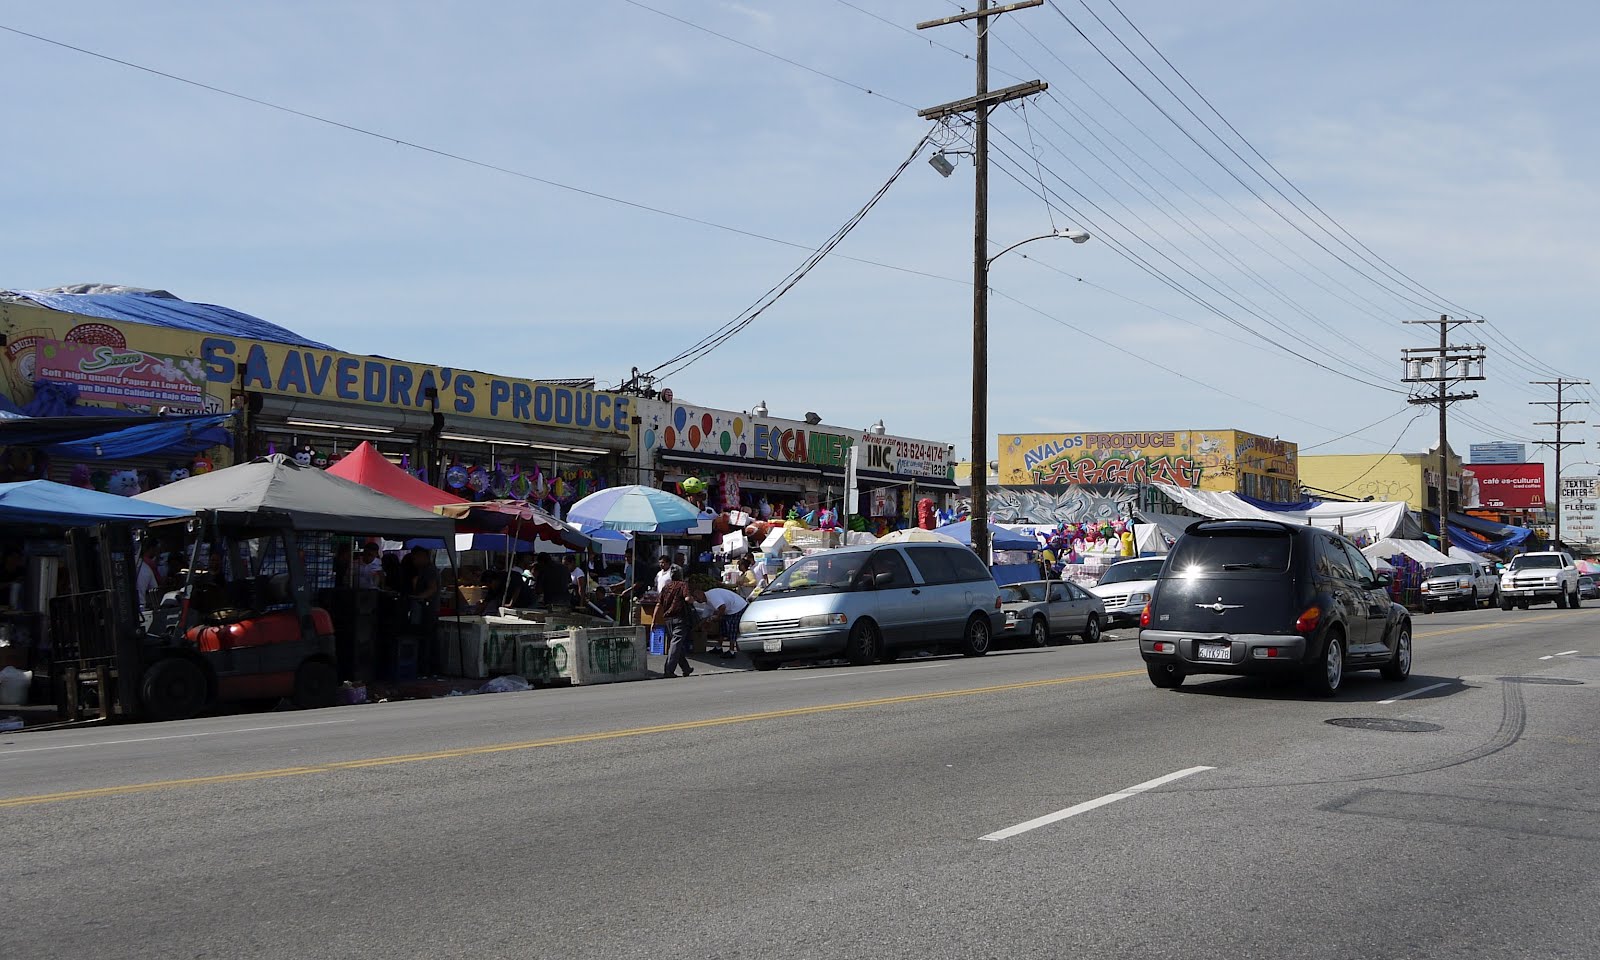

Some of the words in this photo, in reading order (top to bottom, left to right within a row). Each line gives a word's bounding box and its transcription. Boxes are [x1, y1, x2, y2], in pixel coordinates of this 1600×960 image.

[41, 367, 62, 378] Soft
[64, 371, 87, 381] high
[88, 374, 122, 386] quality
[122, 376, 150, 389] Paper
[150, 380, 161, 388] At
[161, 381, 179, 391] Low
[179, 382, 202, 393] Price
[201, 336, 475, 413] SAAVEDRA'S
[489, 380, 630, 432] PRODUCE
[94, 384, 106, 394] De
[106, 386, 123, 395] Alta
[123, 387, 155, 399] Calidad
[162, 391, 179, 402] Bajo
[180, 393, 202, 403] Costo
[754, 423, 854, 468] ESCAMEX
[1023, 435, 1084, 471] AVALOS
[1085, 432, 1176, 449] PRODUCE
[867, 444, 894, 474] INC.
[931, 464, 946, 476] 1238
[1562, 489, 1588, 497] CENTER
[1564, 480, 1594, 488] TEXTILE
